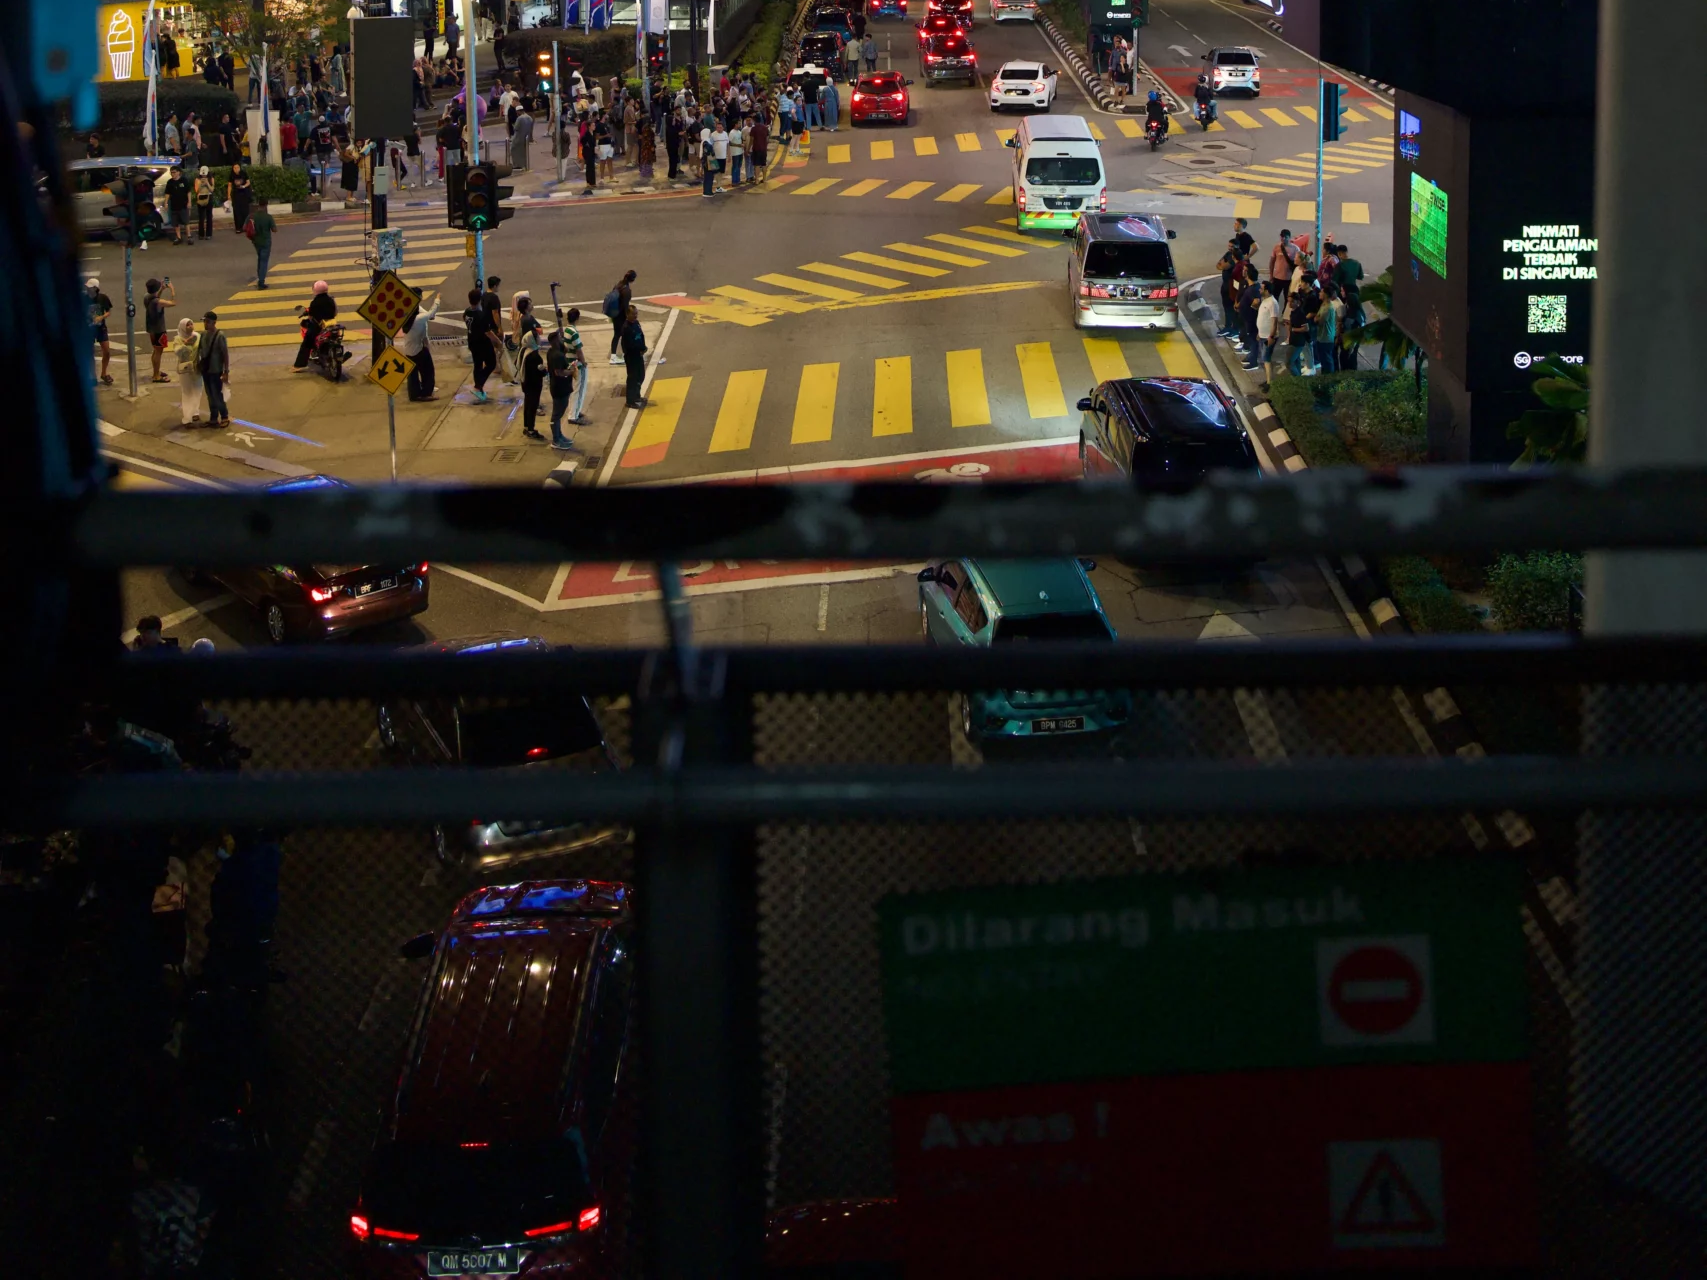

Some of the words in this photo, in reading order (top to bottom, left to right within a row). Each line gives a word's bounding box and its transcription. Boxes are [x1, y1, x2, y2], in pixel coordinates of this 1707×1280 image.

[1522, 224, 1580, 238] NIKMATI
[1502, 238, 1599, 252] PENGALAMAN
[1523, 252, 1579, 266] TERBAIK
[1502, 267, 1518, 280] DI
[1519, 266, 1598, 280] SINGAPURA
[1515, 355, 1530, 365] SG
[902, 906, 1149, 956] Dilarang
[1171, 884, 1368, 932] Masuk
[920, 1111, 1077, 1154] Awas
[441, 1254, 459, 1270] QM
[497, 1252, 508, 1268] M
